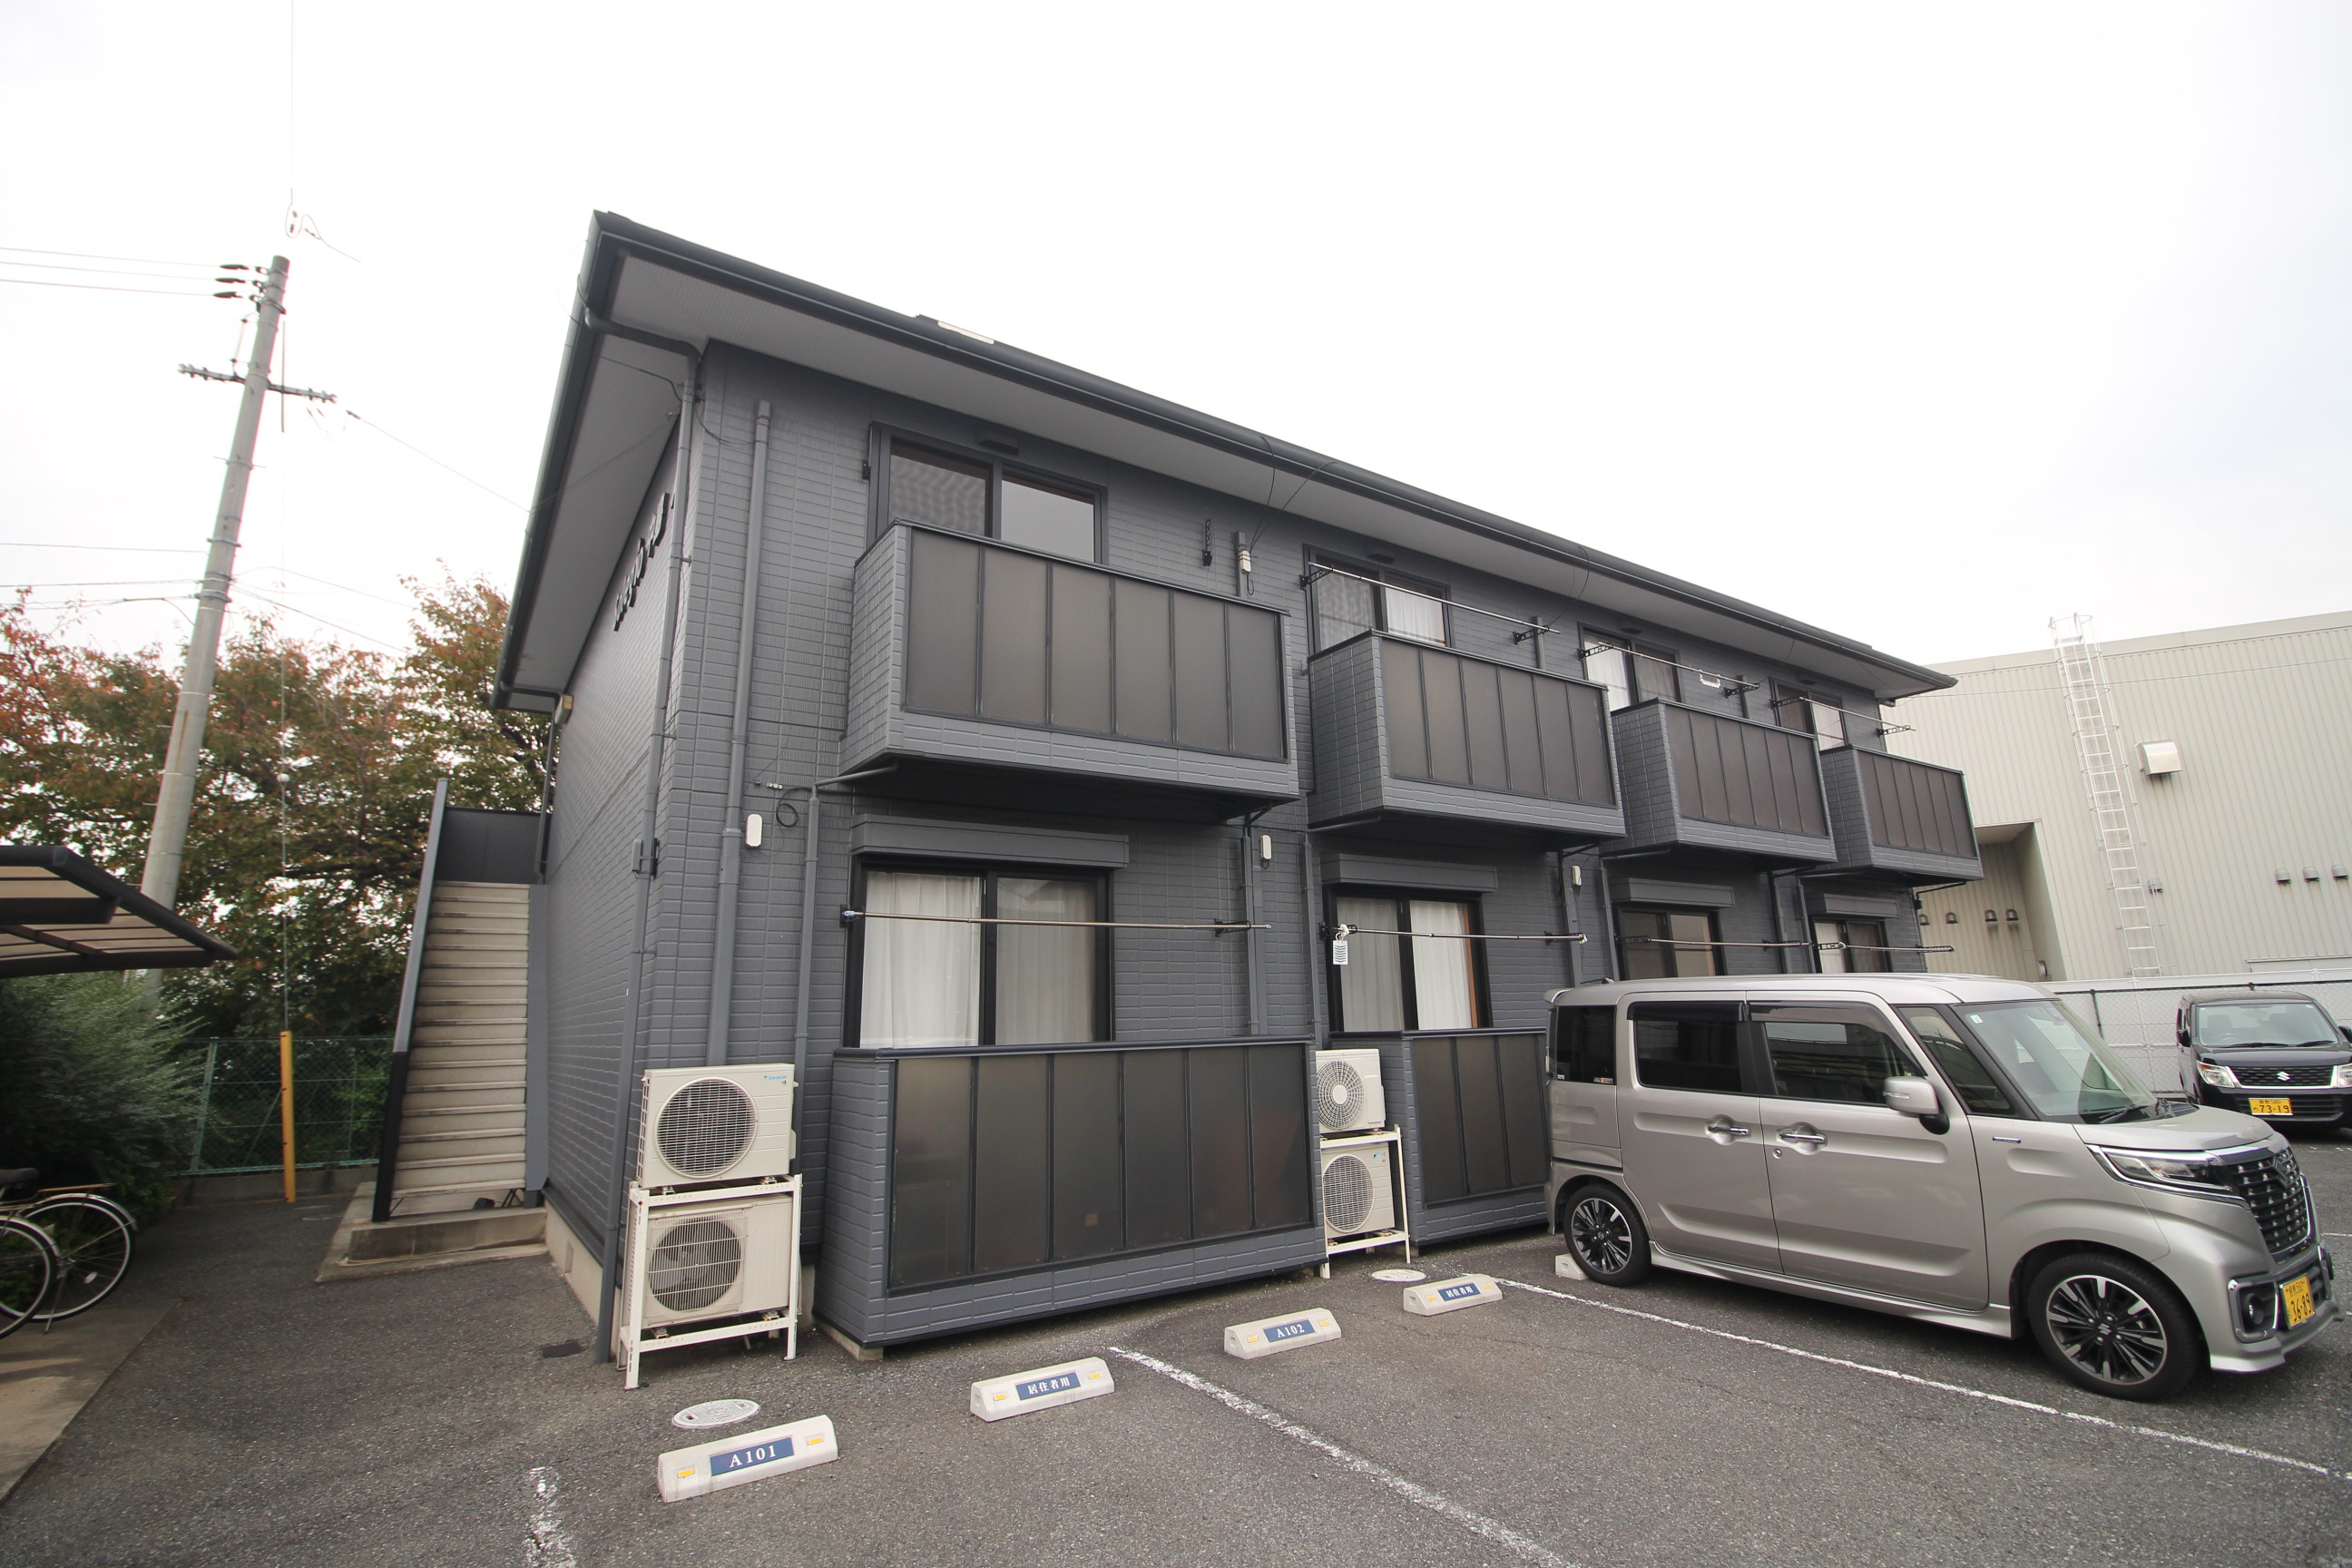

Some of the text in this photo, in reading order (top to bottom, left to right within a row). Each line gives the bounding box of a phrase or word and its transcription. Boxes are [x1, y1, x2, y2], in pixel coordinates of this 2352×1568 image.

[2259, 1104, 2290, 1113] 73-19
[2290, 1292, 2312, 1322] 36-89
[1277, 1324, 1305, 1338] A102
[1027, 1377, 1071, 1395] 居住者用
[729, 1445, 776, 1468] A101
